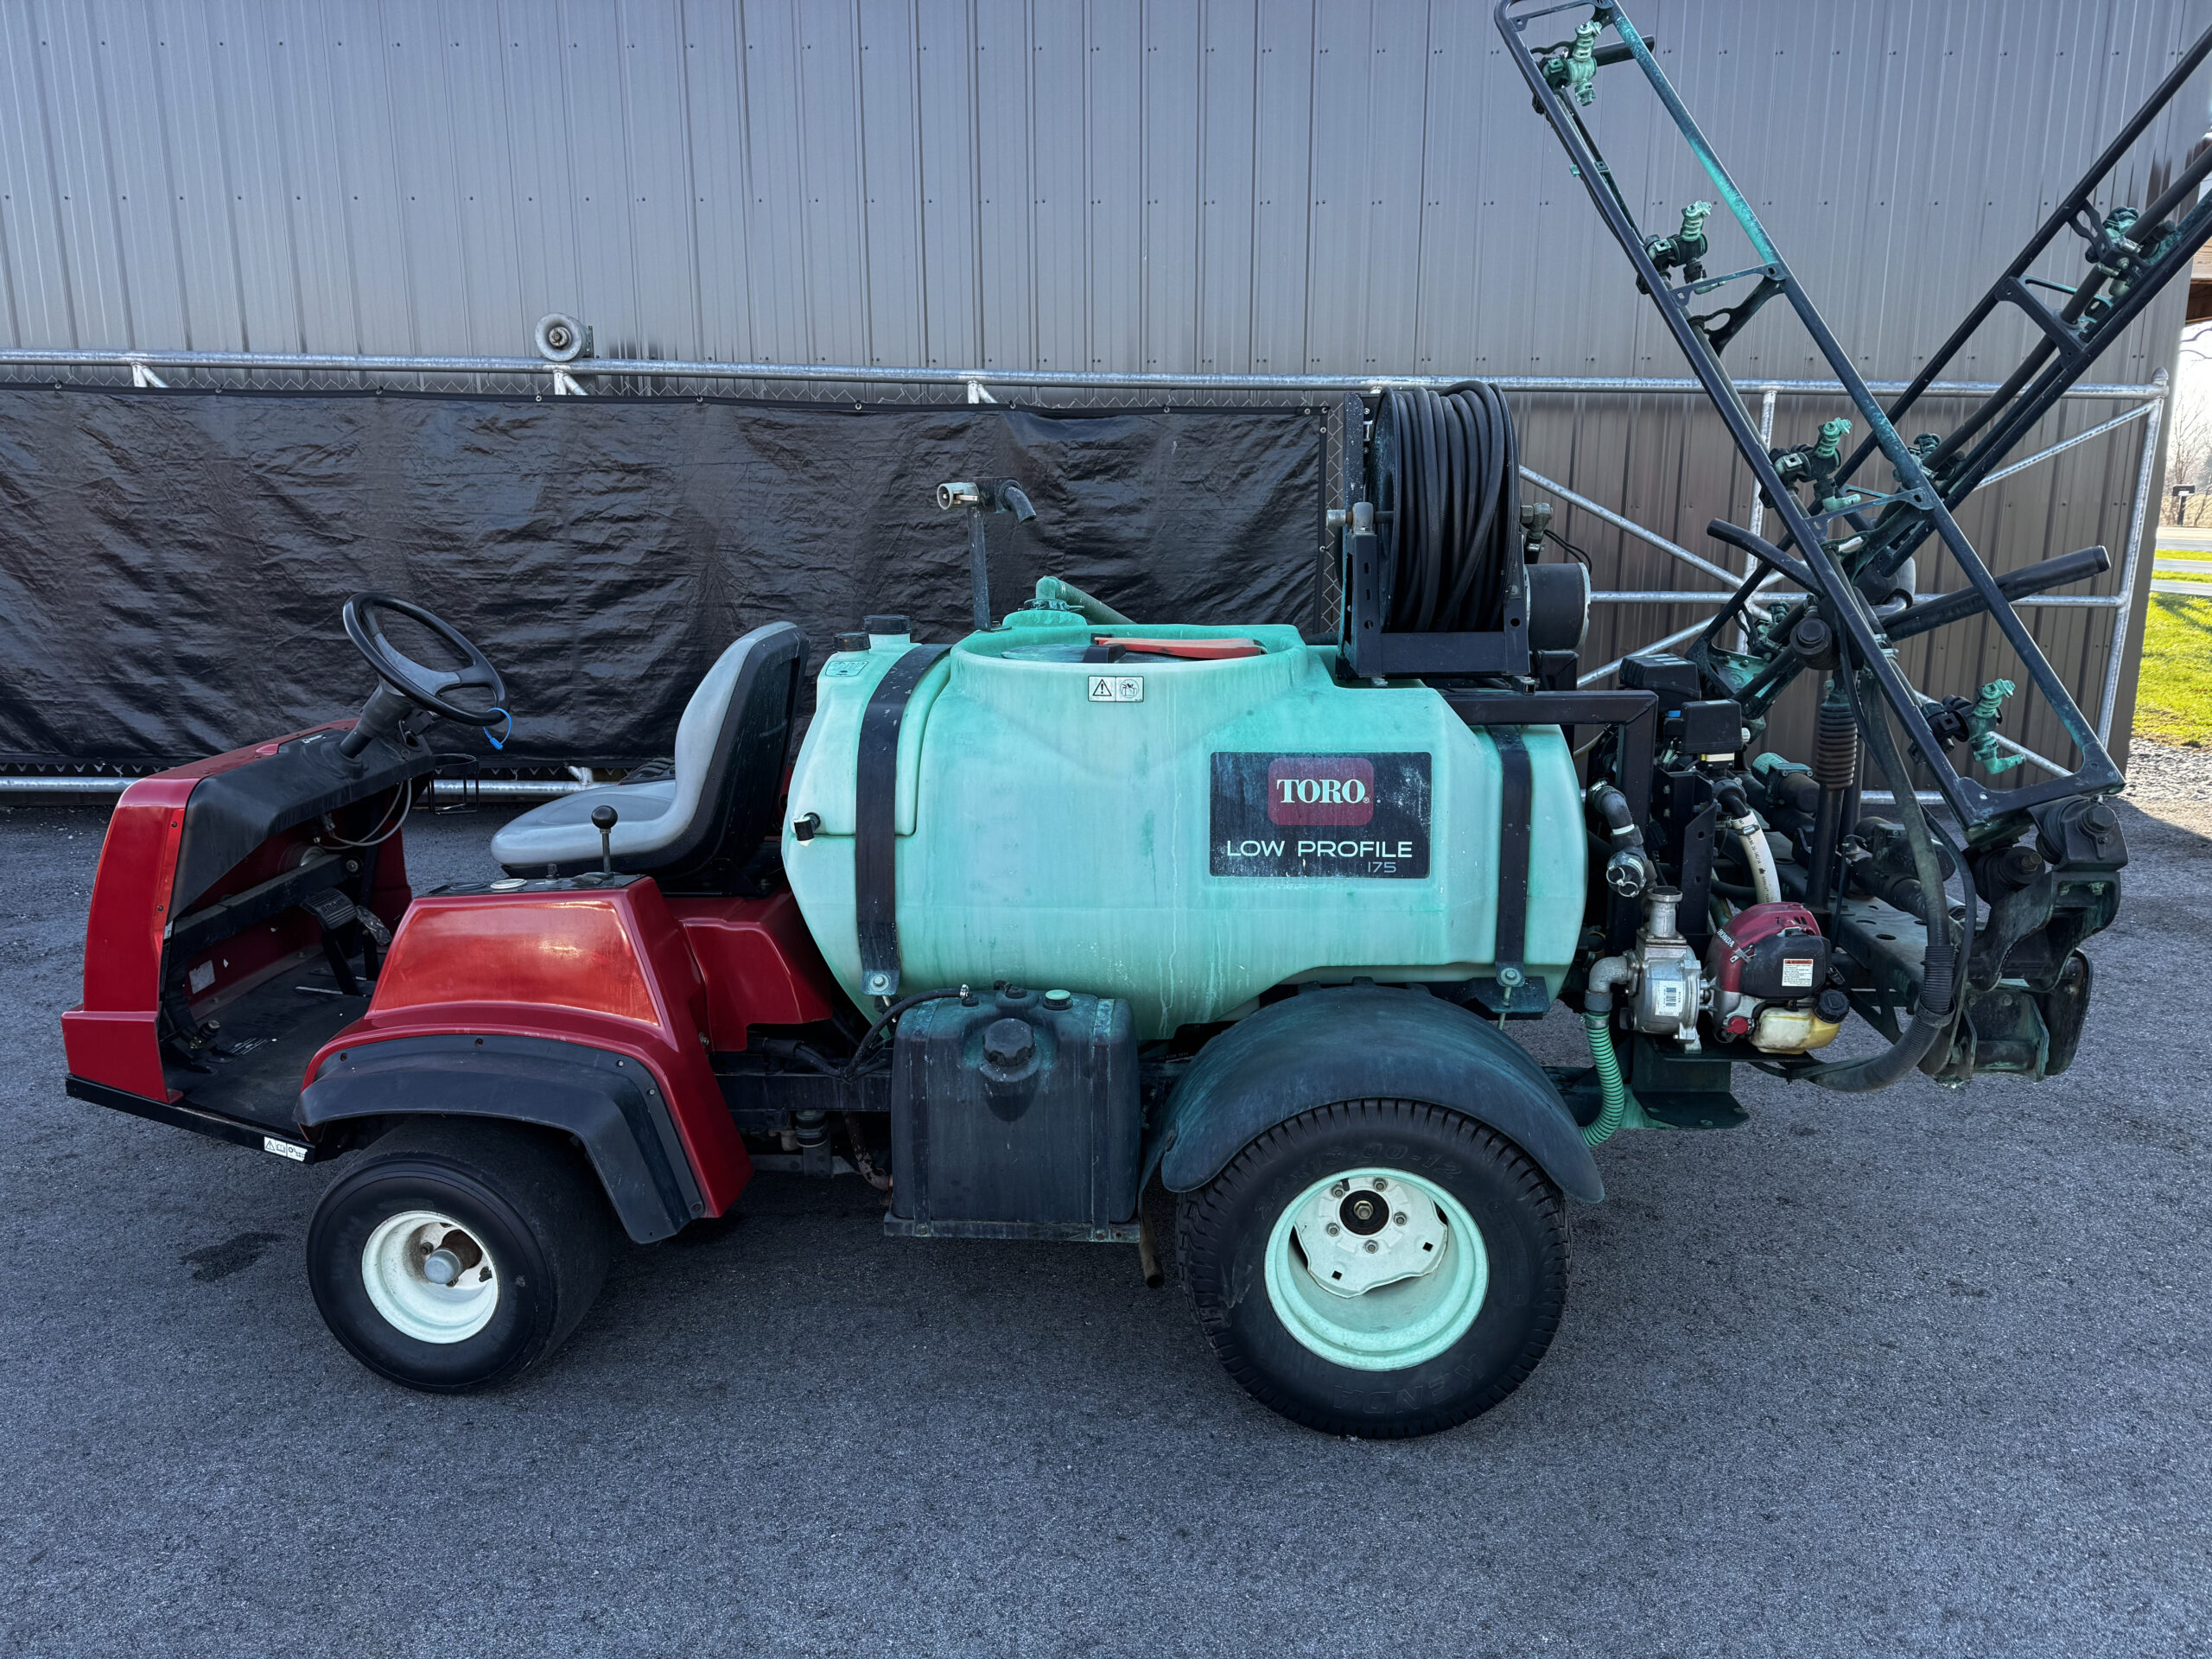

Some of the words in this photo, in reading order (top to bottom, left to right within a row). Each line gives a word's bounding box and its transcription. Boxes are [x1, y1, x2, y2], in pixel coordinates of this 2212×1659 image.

[1276, 779, 1366, 804] TORO
[1227, 840, 1286, 857] LOW
[1297, 841, 1413, 858] PROFILE
[1367, 861, 1397, 874] 175
[1716, 928, 1735, 948] HONDA
[1332, 1353, 1486, 1415] KENDA
